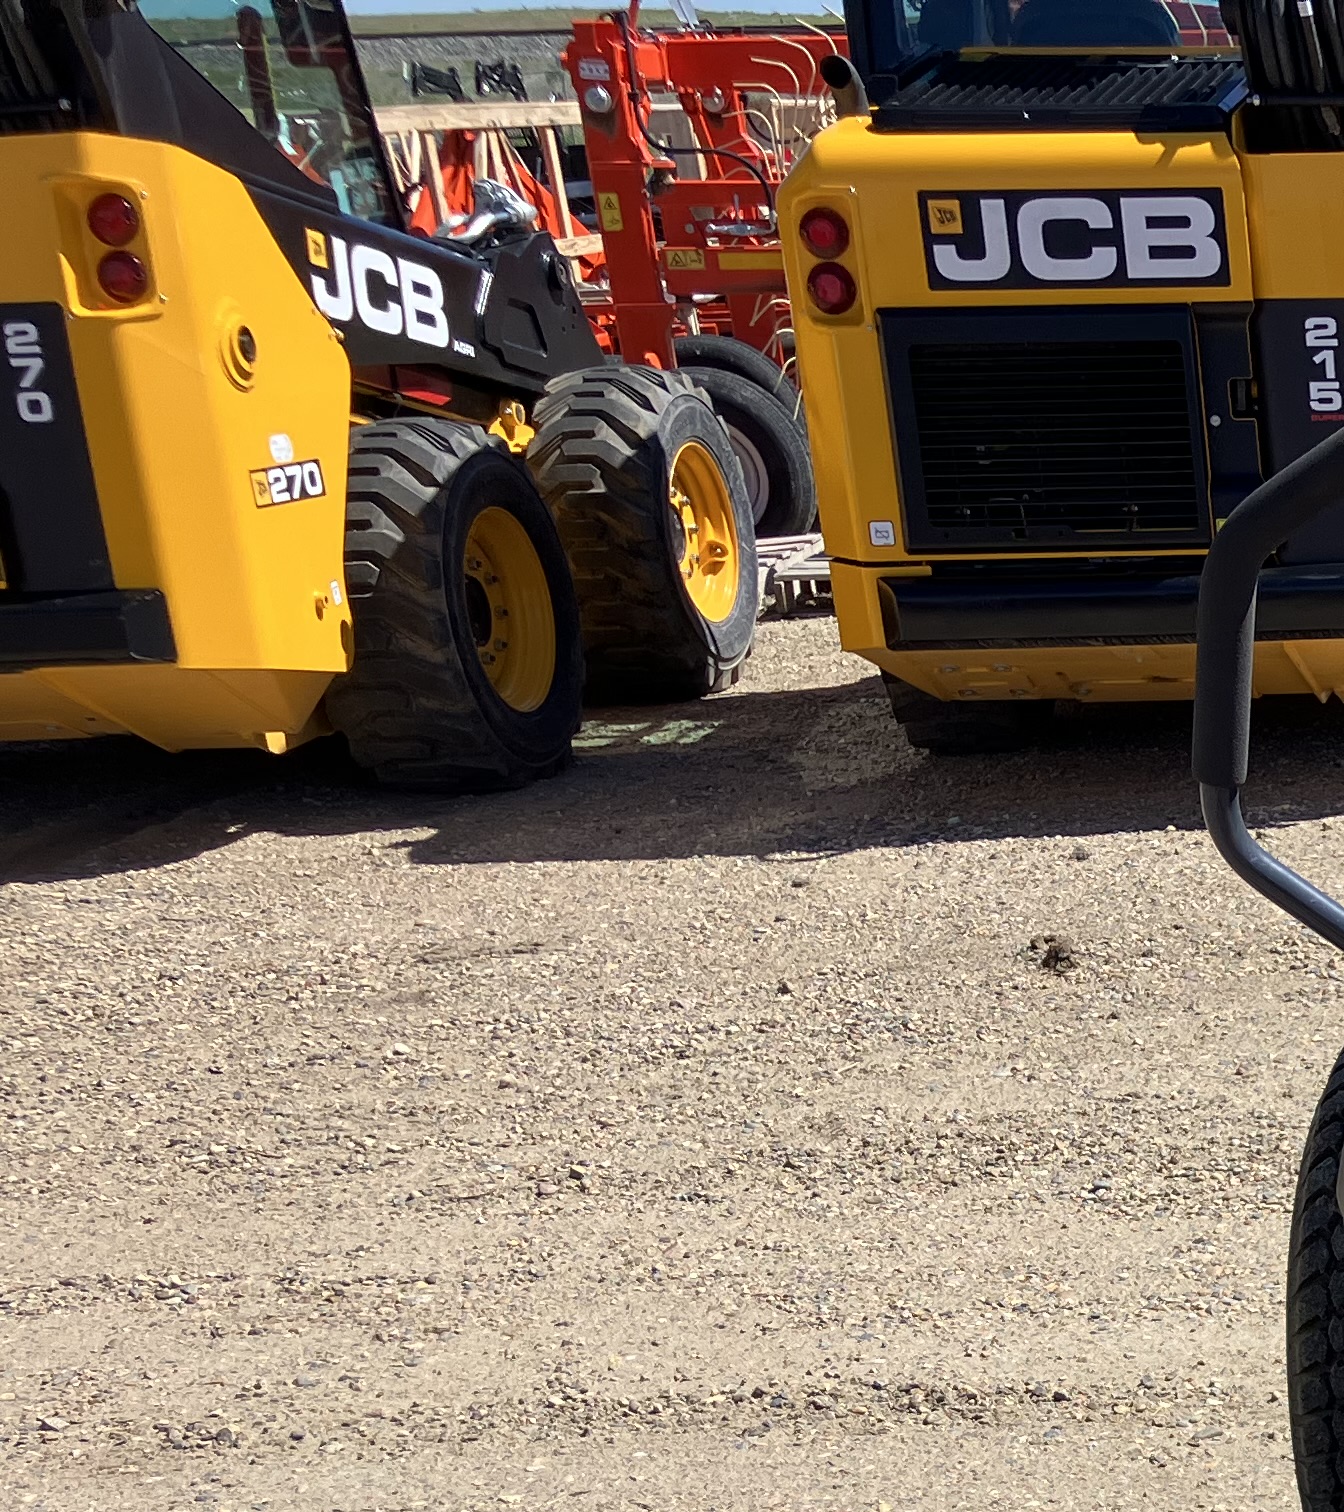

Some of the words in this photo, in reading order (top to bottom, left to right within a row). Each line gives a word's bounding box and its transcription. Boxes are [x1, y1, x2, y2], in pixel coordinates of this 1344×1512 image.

[933, 197, 1222, 282] JCB
[310, 234, 449, 348] JCB
[3, 322, 54, 423] 270
[1304, 316, 1343, 412] 215
[268, 461, 324, 504] 270
